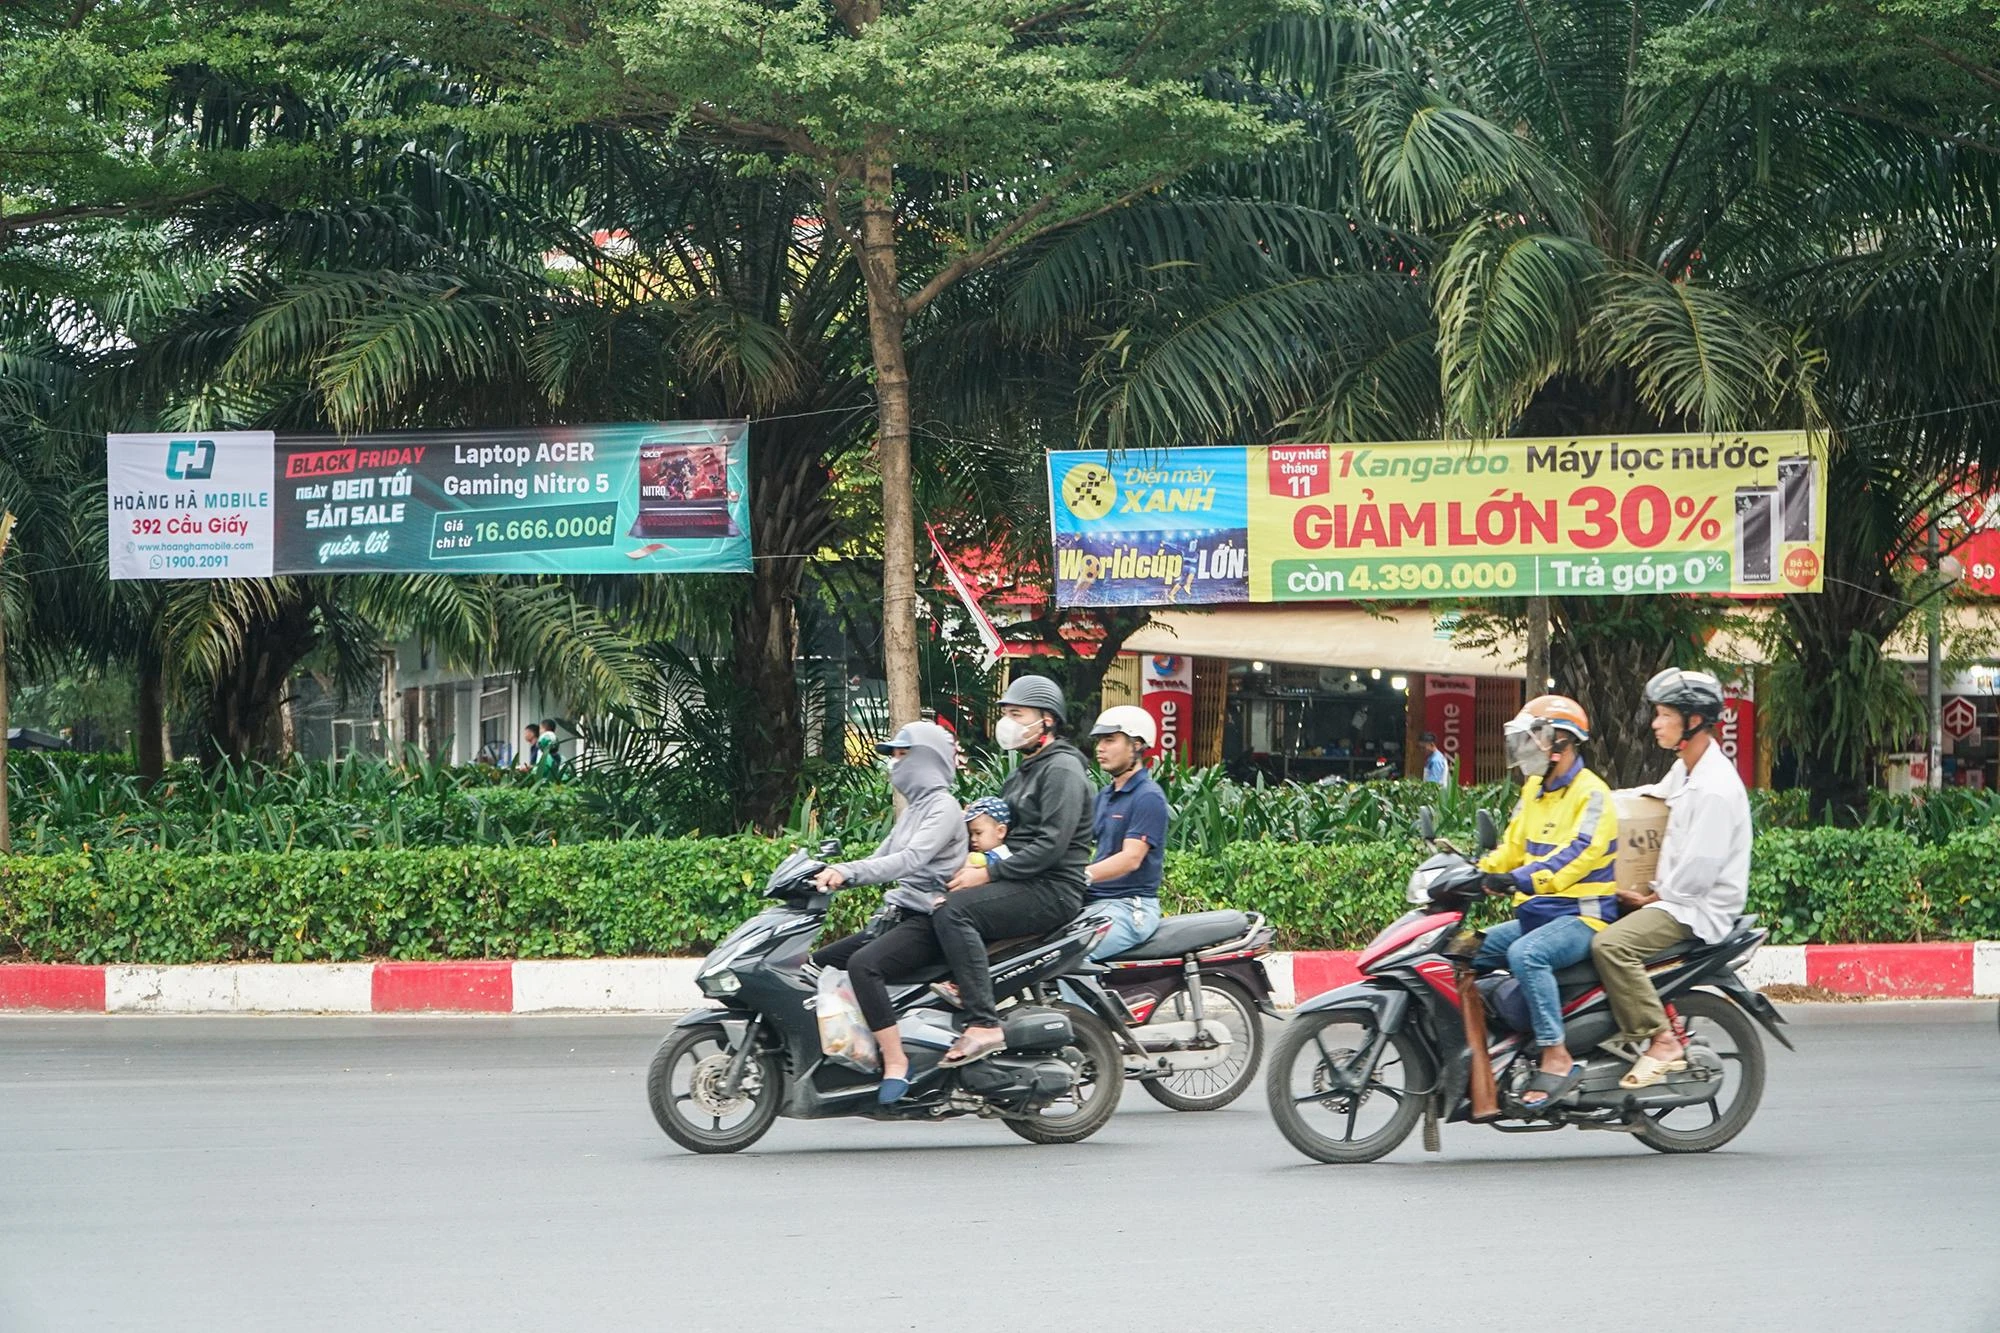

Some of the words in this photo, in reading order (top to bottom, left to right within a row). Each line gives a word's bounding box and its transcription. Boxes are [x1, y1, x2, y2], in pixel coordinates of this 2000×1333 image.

[291, 454, 352, 475] BLACK
[358, 447, 426, 468] FRIDAY
[455, 443, 530, 467] Laptop
[535, 442, 595, 462] ACER
[1272, 450, 1297, 462] Duy
[1298, 448, 1328, 461] nhất
[1526, 443, 1600, 478] Máy
[1610, 442, 1663, 478] lọc
[1671, 437, 1770, 469] nước
[1123, 466, 1172, 485] Điện
[1173, 465, 1217, 486] máy
[1281, 462, 1318, 475] tháng
[296, 484, 329, 500] NGÀY
[332, 478, 375, 501] ĐEN
[378, 467, 413, 497] TỐI
[443, 474, 529, 499] Gaming
[534, 474, 590, 494] Nitro
[596, 474, 610, 493] 5
[642, 485, 666, 497] NITRO
[1288, 475, 1312, 497] 11
[114, 490, 169, 510] HOÀNG
[175, 489, 198, 509] HÀ
[204, 492, 269, 508] MOBILE
[1120, 488, 1217, 514] XANH
[132, 518, 161, 534] 392
[167, 513, 202, 534] Cầu
[208, 514, 248, 536] Giấy
[305, 503, 348, 529] SĂN
[350, 503, 405, 525] SALE
[443, 519, 464, 532] Giá
[474, 514, 614, 542] 16.666.000đ
[1293, 487, 1437, 549] GIẢM
[1447, 487, 1559, 547] LỚN
[1568, 484, 1721, 550] 30%
[137, 541, 254, 553] www.hoanghamobile.com
[318, 535, 361, 564] quên
[364, 530, 391, 554] lối
[436, 534, 455, 549] chỉ
[455, 534, 473, 548] từ
[165, 555, 229, 568] 1900.2091
[1197, 543, 1246, 579] LỚN
[1550, 557, 1609, 588] Trả
[1612, 555, 1678, 593] góp
[1684, 554, 1725, 586] 0%
[1288, 564, 1344, 593] còn
[1348, 561, 1517, 591] 4.390.000
